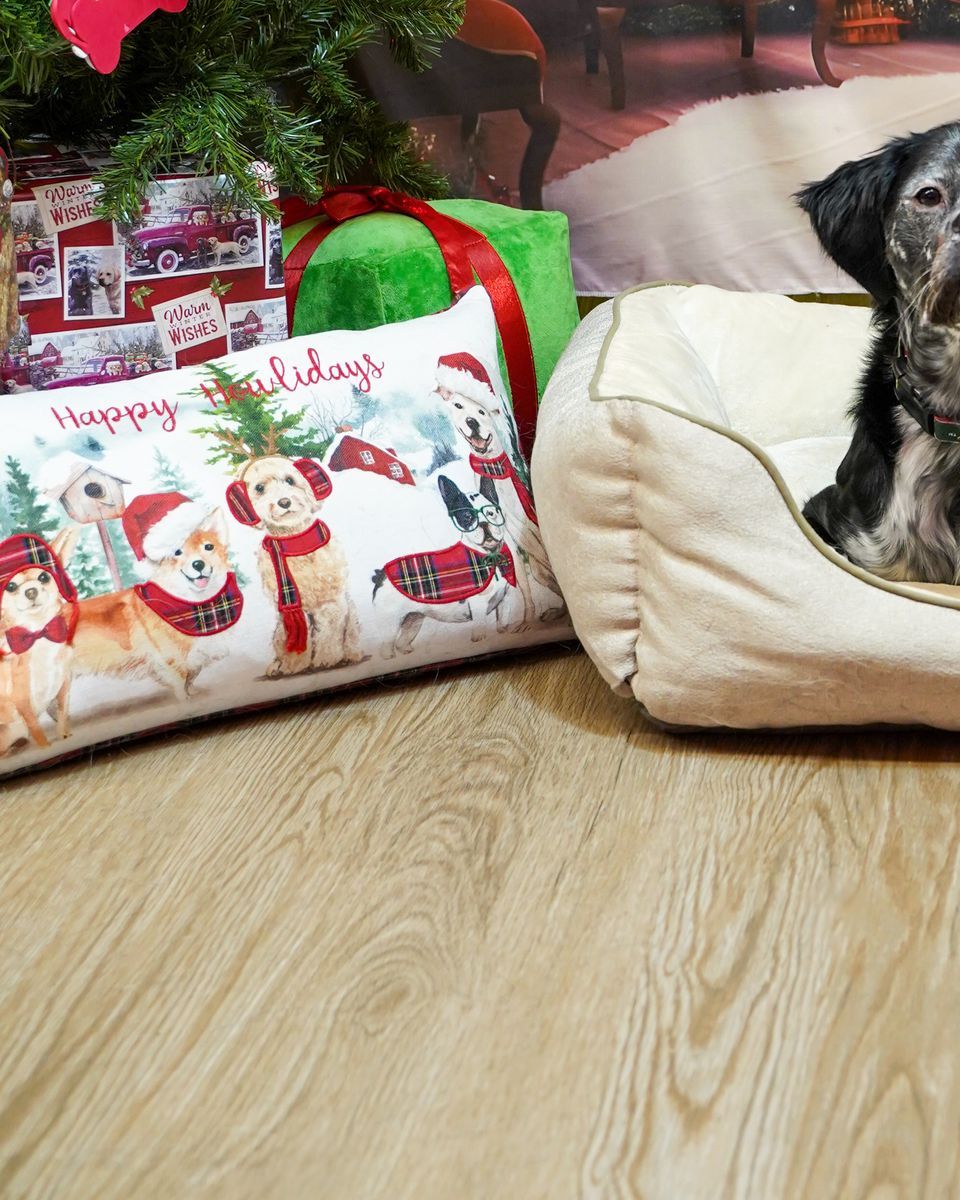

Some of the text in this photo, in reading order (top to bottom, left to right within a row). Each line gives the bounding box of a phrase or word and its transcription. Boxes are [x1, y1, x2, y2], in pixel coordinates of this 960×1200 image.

[45, 184, 94, 203] Warm
[164, 302, 211, 324] Warm
[168, 319, 218, 346] WISHES
[50, 347, 385, 435] Happy Howlidays
